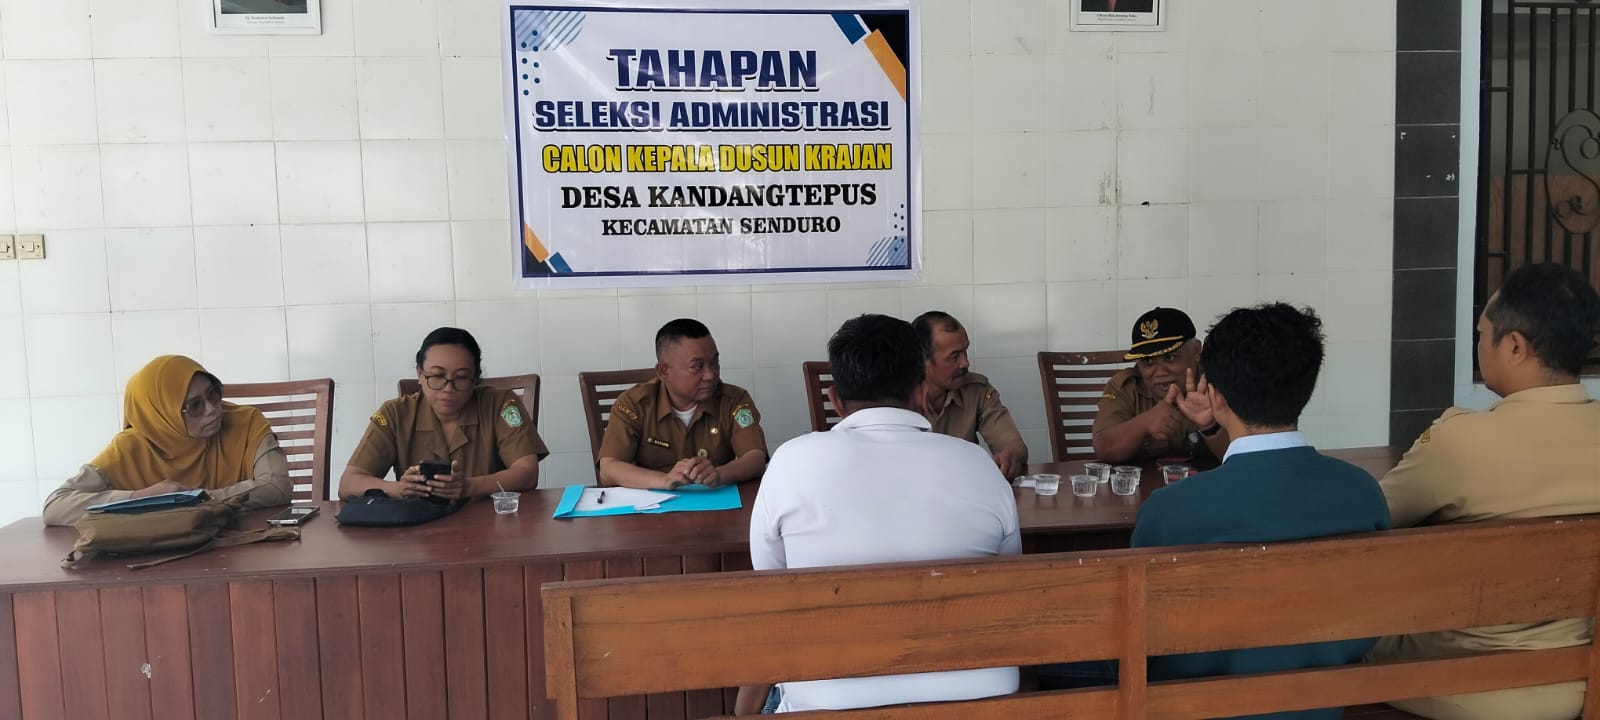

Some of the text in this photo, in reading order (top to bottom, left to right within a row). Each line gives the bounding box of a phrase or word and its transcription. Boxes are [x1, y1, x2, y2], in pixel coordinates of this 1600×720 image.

[607, 48, 820, 91] TAHAPAN
[533, 100, 891, 131] SELEKSI ADMINISTRASI
[542, 143, 893, 173] CALON KEPALA DUSUN KRAJAN
[561, 183, 877, 209] DESA KANDANGTEPUS
[602, 215, 841, 236] KECAMATAN SENDURO
